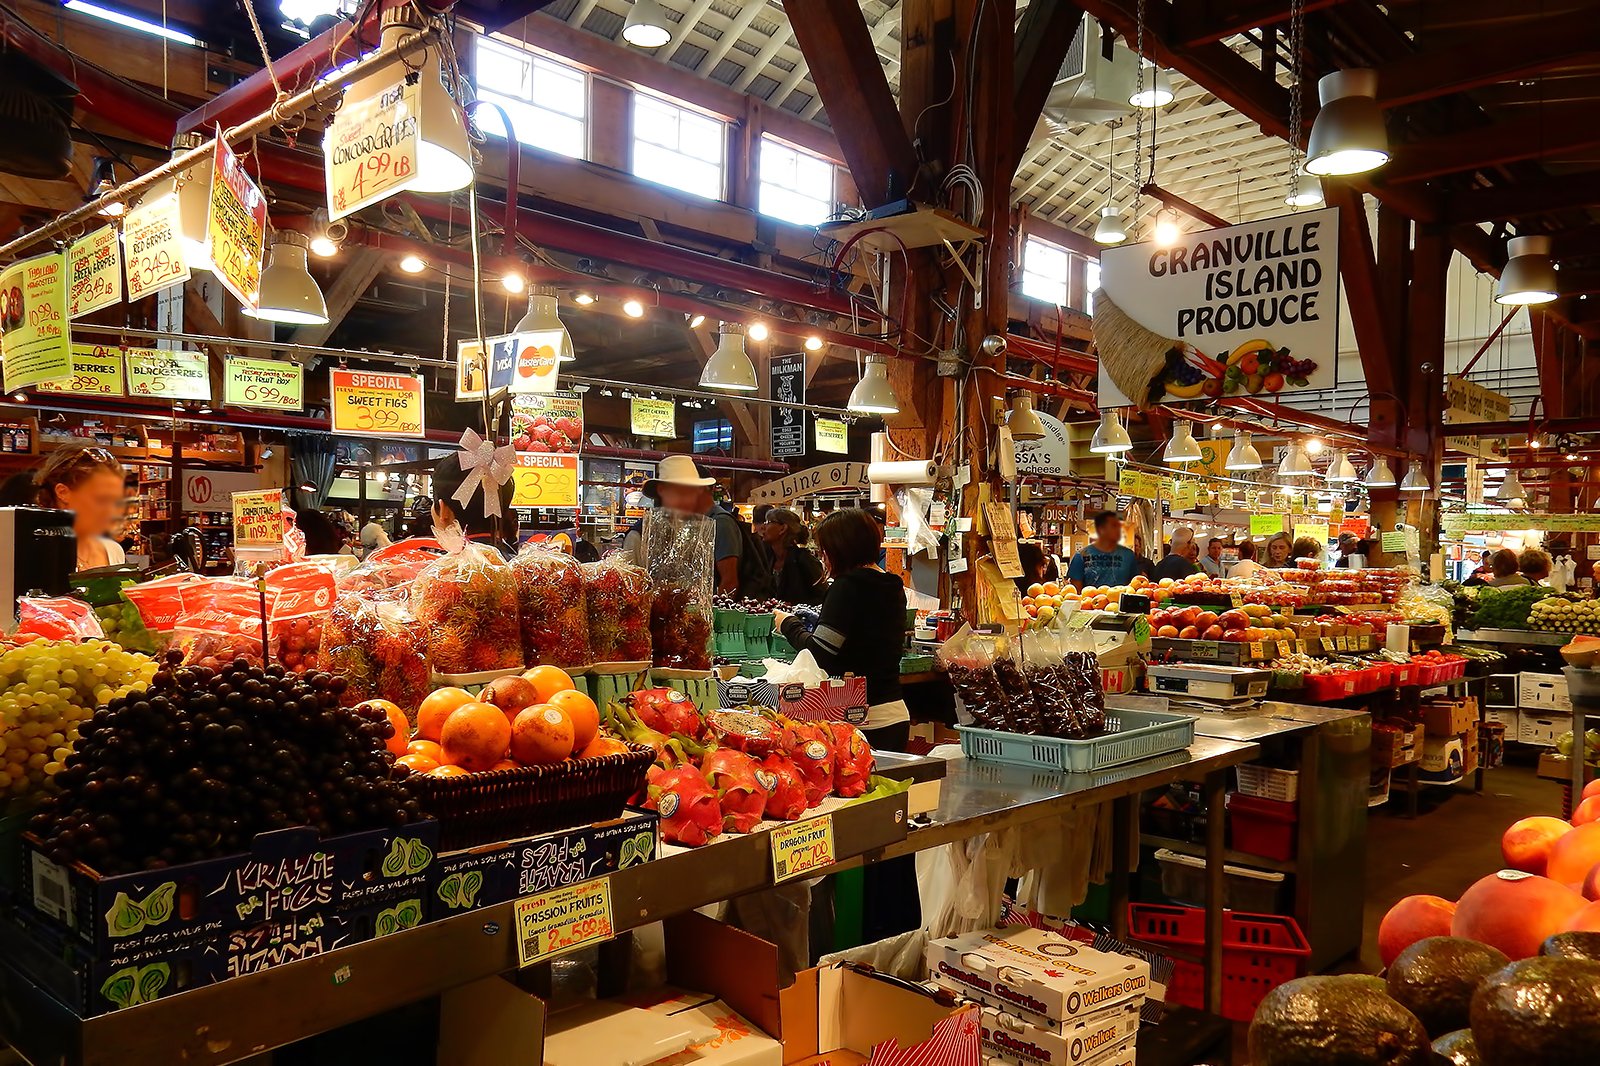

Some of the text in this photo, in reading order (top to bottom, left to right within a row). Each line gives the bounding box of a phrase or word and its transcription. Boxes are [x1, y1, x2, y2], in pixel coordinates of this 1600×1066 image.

[333, 116, 418, 166] CONCORD GRAPES
[394, 155, 411, 177] LB
[133, 228, 172, 254] RED GRAPES
[1149, 221, 1320, 277] GRANVILLE
[74, 254, 116, 282] GREEN GRAPES
[171, 261, 181, 275] LB
[1206, 258, 1322, 300] ISLAND
[105, 283, 113, 294] LB
[1177, 291, 1319, 337] PRODUCE
[134, 366, 203, 378] BLACKBERRIES
[495, 359, 513, 371] VISA
[518, 356, 556, 368] MasterCard
[772, 363, 802, 375] MILKMAN
[234, 374, 290, 386] MIX FRUIT BOX
[352, 374, 404, 389] SPECIAL
[348, 395, 408, 409] SWEET FIGS
[523, 455, 565, 468] SPECIAL
[1014, 452, 1051, 464] SSA'S
[1025, 465, 1061, 474] cheese
[781, 470, 821, 497] Line
[830, 463, 851, 486] of
[1046, 509, 1079, 521] DUSA'S
[775, 829, 792, 839] Fresh
[780, 835, 807, 850] DRAGON
[808, 828, 826, 841] FRUIT
[521, 836, 569, 869] FIGS
[568, 837, 587, 858] FOR
[790, 849, 802, 873] 2
[236, 851, 335, 896] KRAZIE
[518, 857, 586, 894] KRAZIE
[235, 895, 263, 921] FOR
[265, 882, 332, 920] FIGS
[521, 899, 546, 912] Fresh
[523, 893, 603, 927] PASSION FRUITS
[144, 932, 170, 947] FIGS
[547, 929, 559, 952] 2
[982, 934, 1097, 977] Walkers Own
[938, 960, 992, 993] Canadian
[993, 983, 1048, 1015] Cherries
[1083, 975, 1146, 1007] Walkers Own
[992, 1030, 1052, 1062] Cherries
[1083, 1025, 1118, 1053] Walkers
